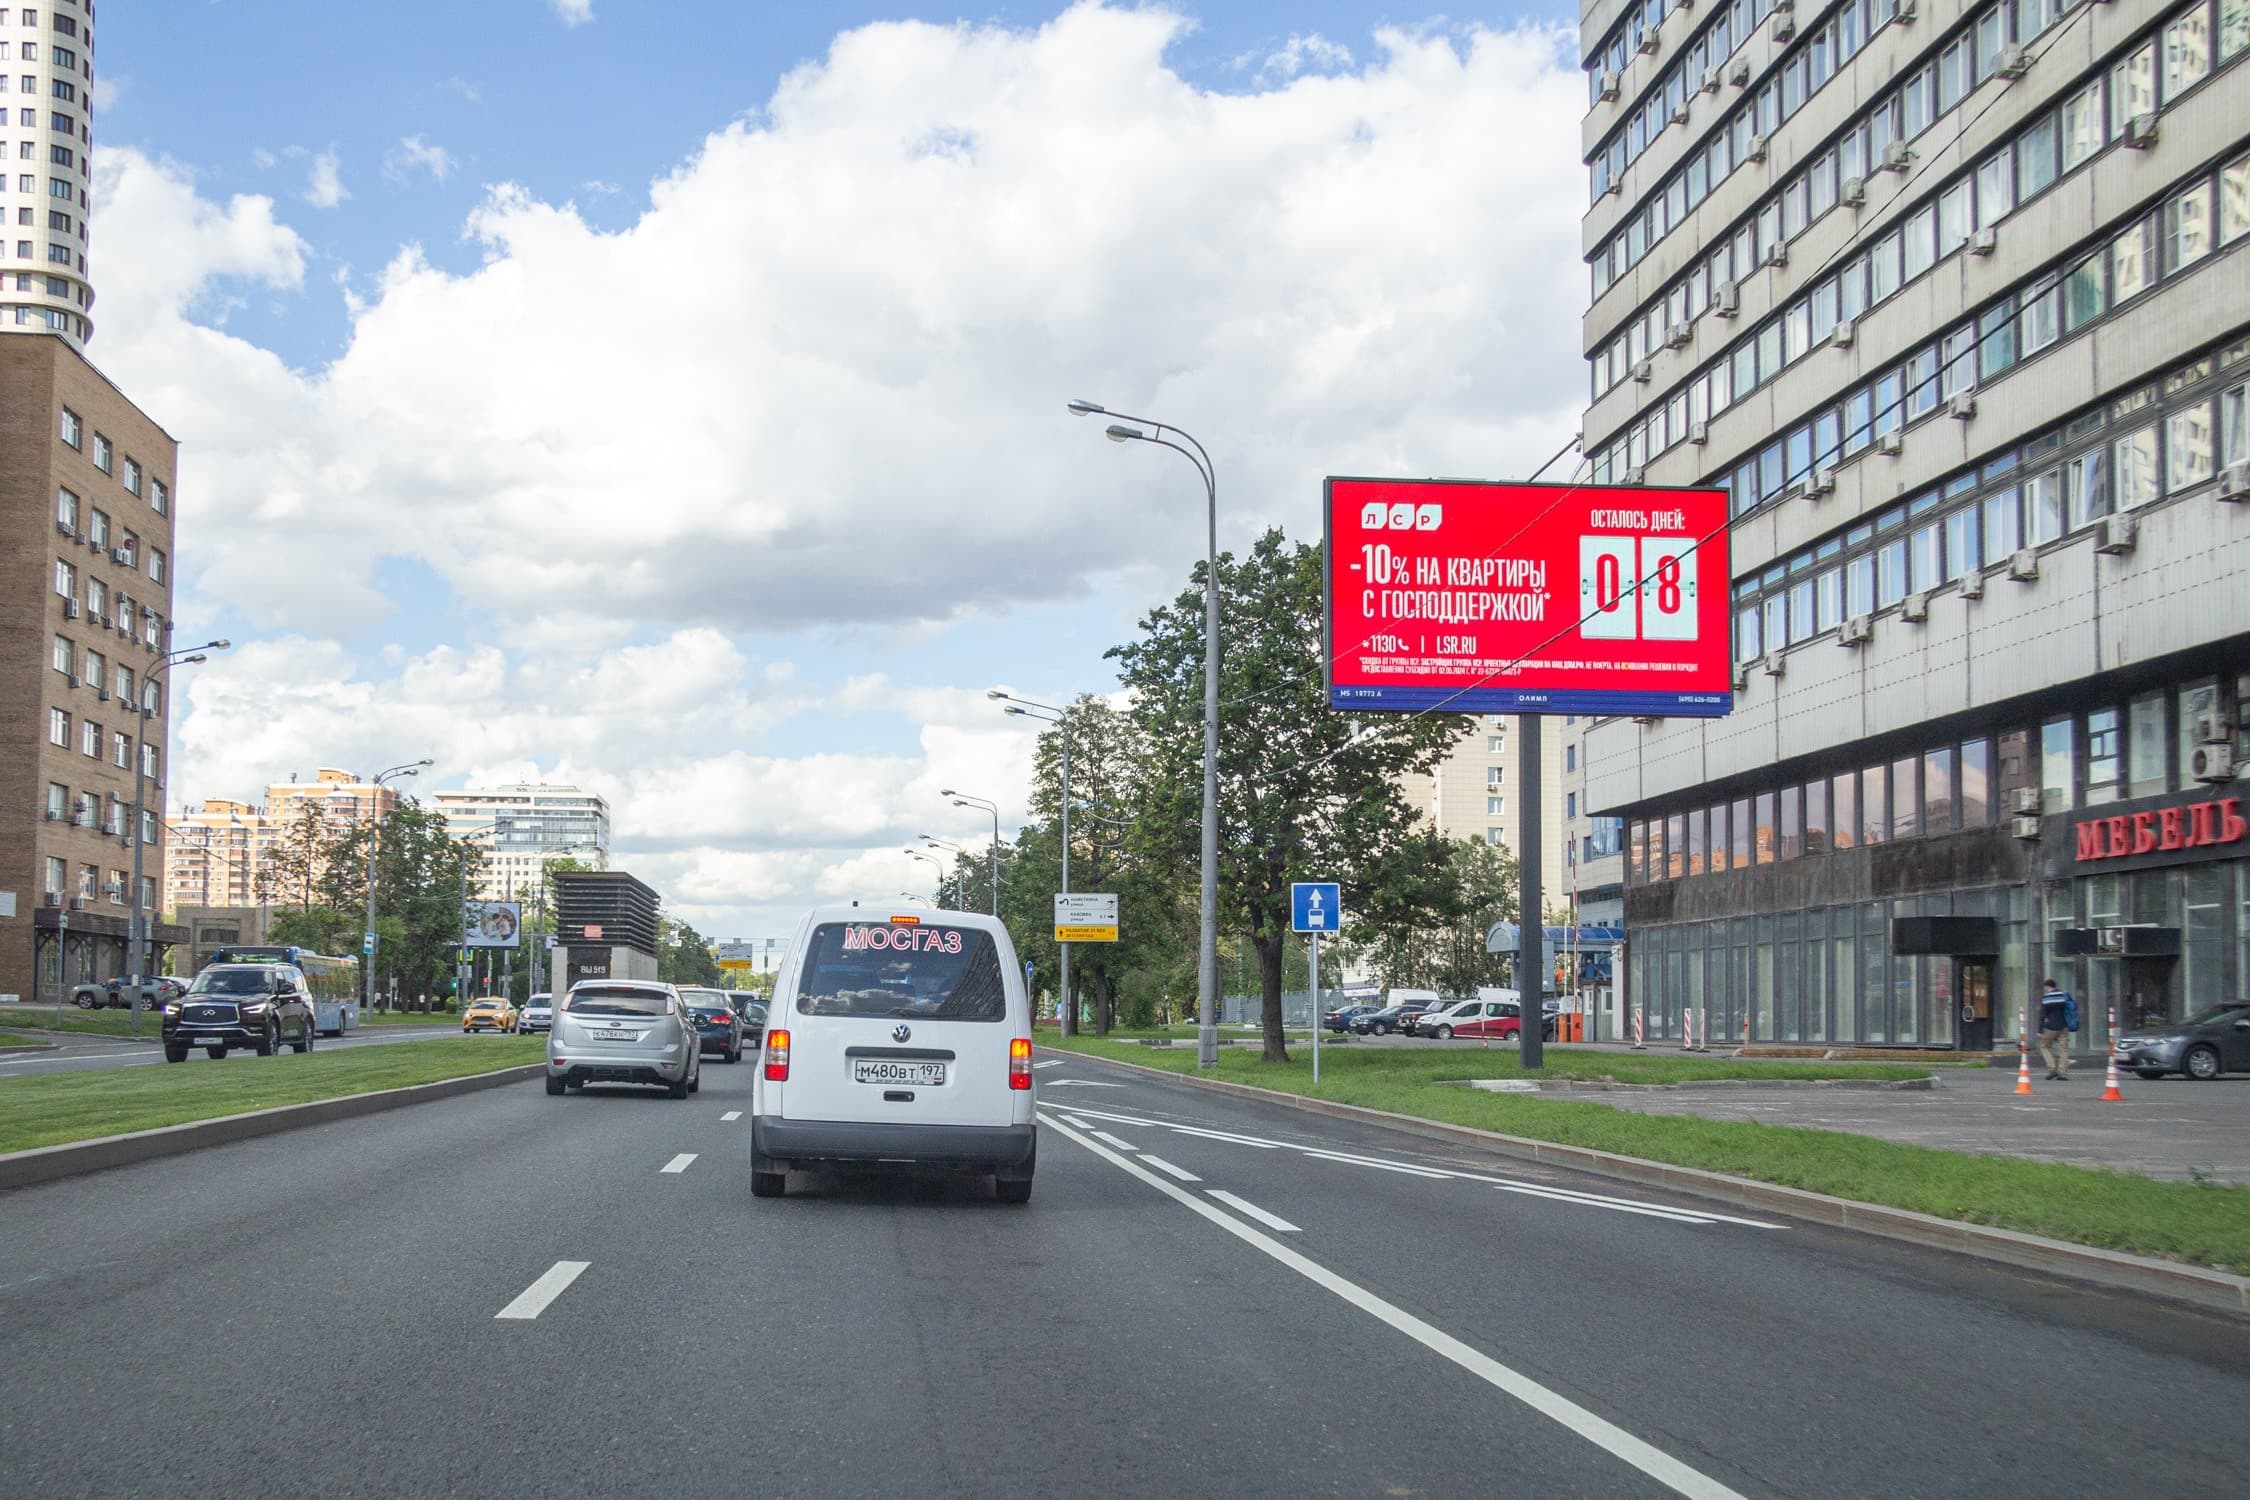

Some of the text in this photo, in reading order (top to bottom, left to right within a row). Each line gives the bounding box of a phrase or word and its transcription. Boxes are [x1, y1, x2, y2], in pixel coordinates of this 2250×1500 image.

[1590, 508, 1686, 532] ОСТАЛОСЬ ДНЕЙ:
[1350, 544, 1546, 588] -10% НА КВАРТИРЫ
[1362, 589, 1375, 618] С
[1436, 635, 1477, 655] LSR.RU
[2074, 797, 2247, 862] МЕБЕЛЬ
[844, 927, 962, 954] МОСГАЗ
[919, 1065, 940, 1076] 197
